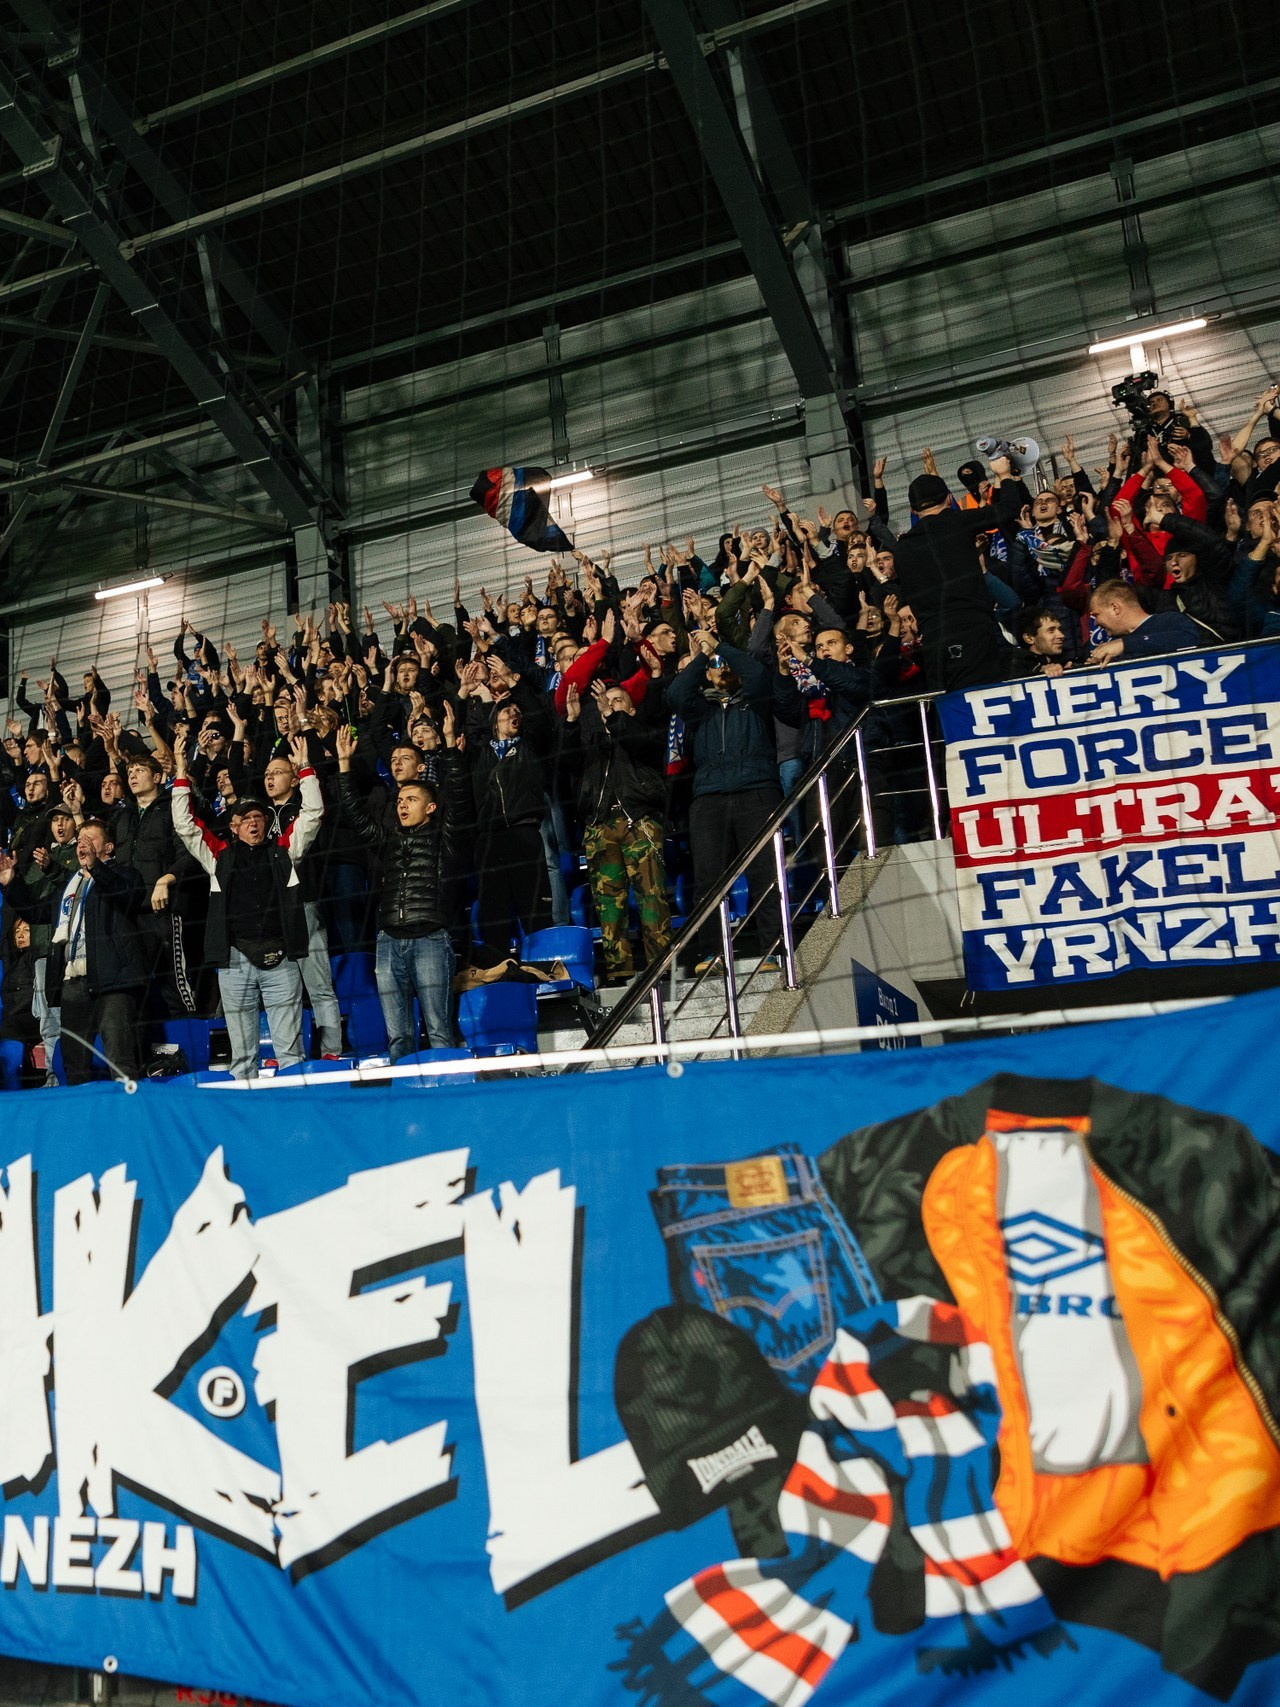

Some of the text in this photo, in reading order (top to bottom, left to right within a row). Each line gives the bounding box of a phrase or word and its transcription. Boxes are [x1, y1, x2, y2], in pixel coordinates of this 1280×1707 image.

[964, 654, 1246, 737] FIERY
[959, 712, 1273, 798] FORCE
[976, 841, 1280, 922] FAKEL
[984, 902, 1280, 984] VRNZH
